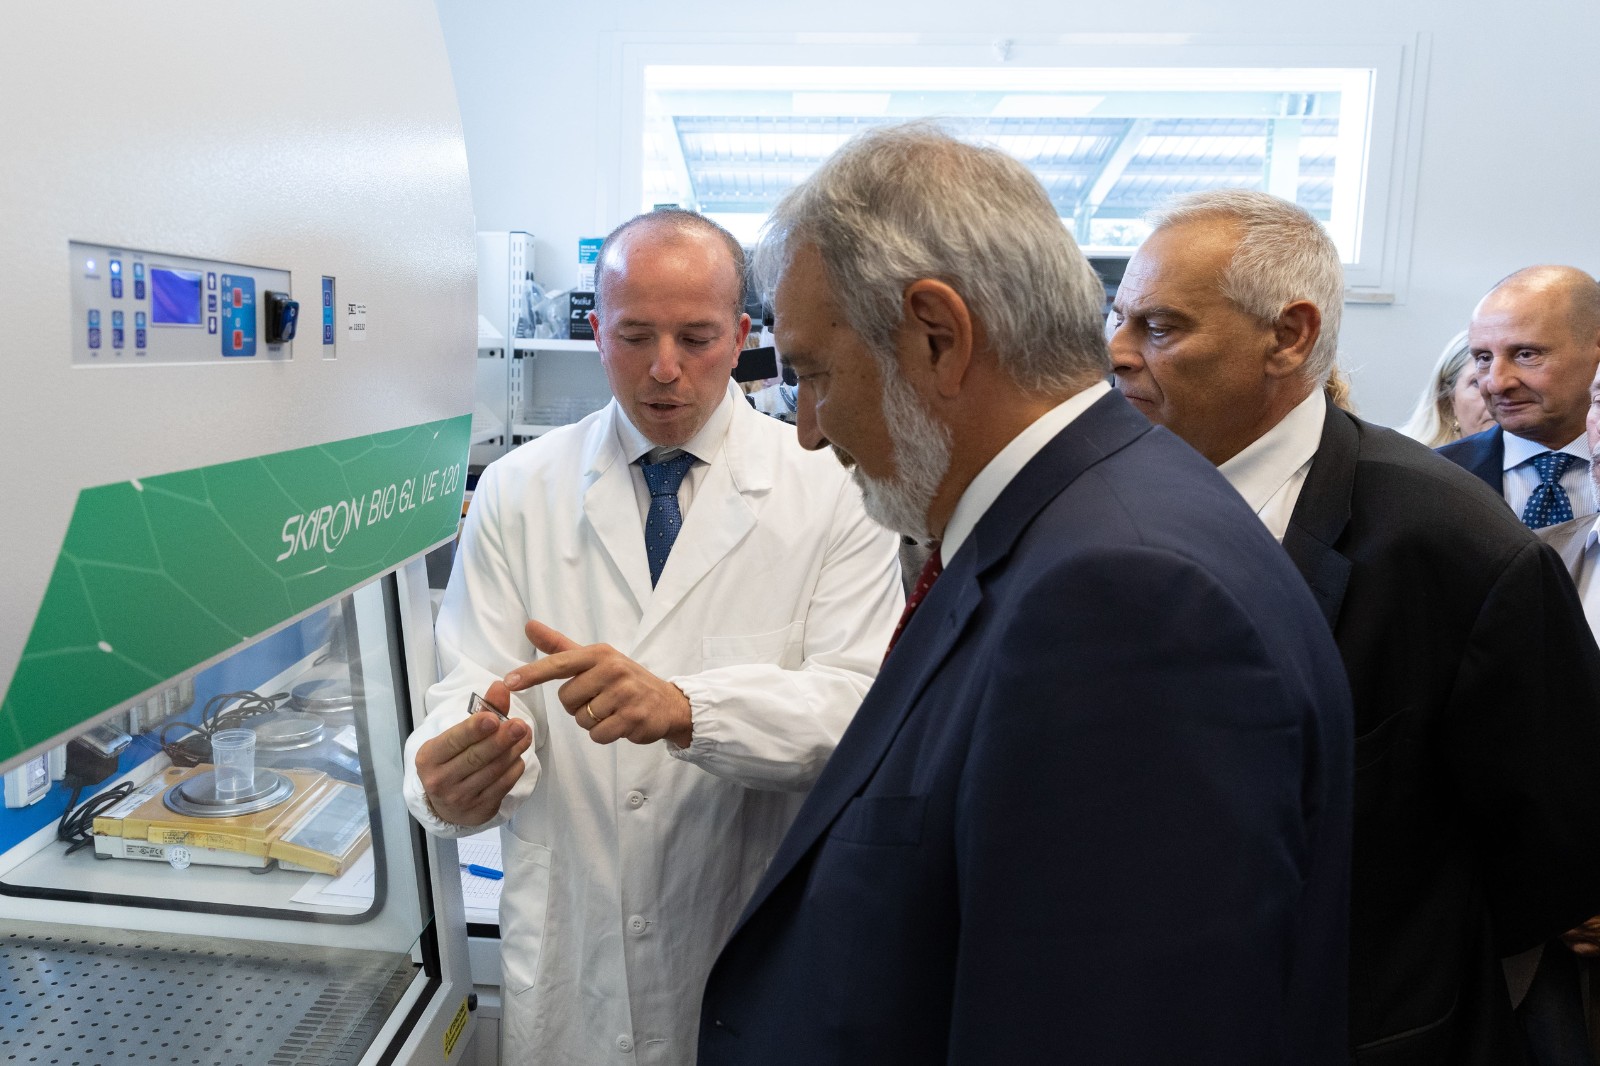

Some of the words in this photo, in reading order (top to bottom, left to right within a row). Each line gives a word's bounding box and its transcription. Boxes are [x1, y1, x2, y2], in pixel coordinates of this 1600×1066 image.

[367, 483, 397, 526] BIO
[399, 477, 416, 513] GL
[421, 469, 439, 505] VE
[440, 463, 460, 497] 120
